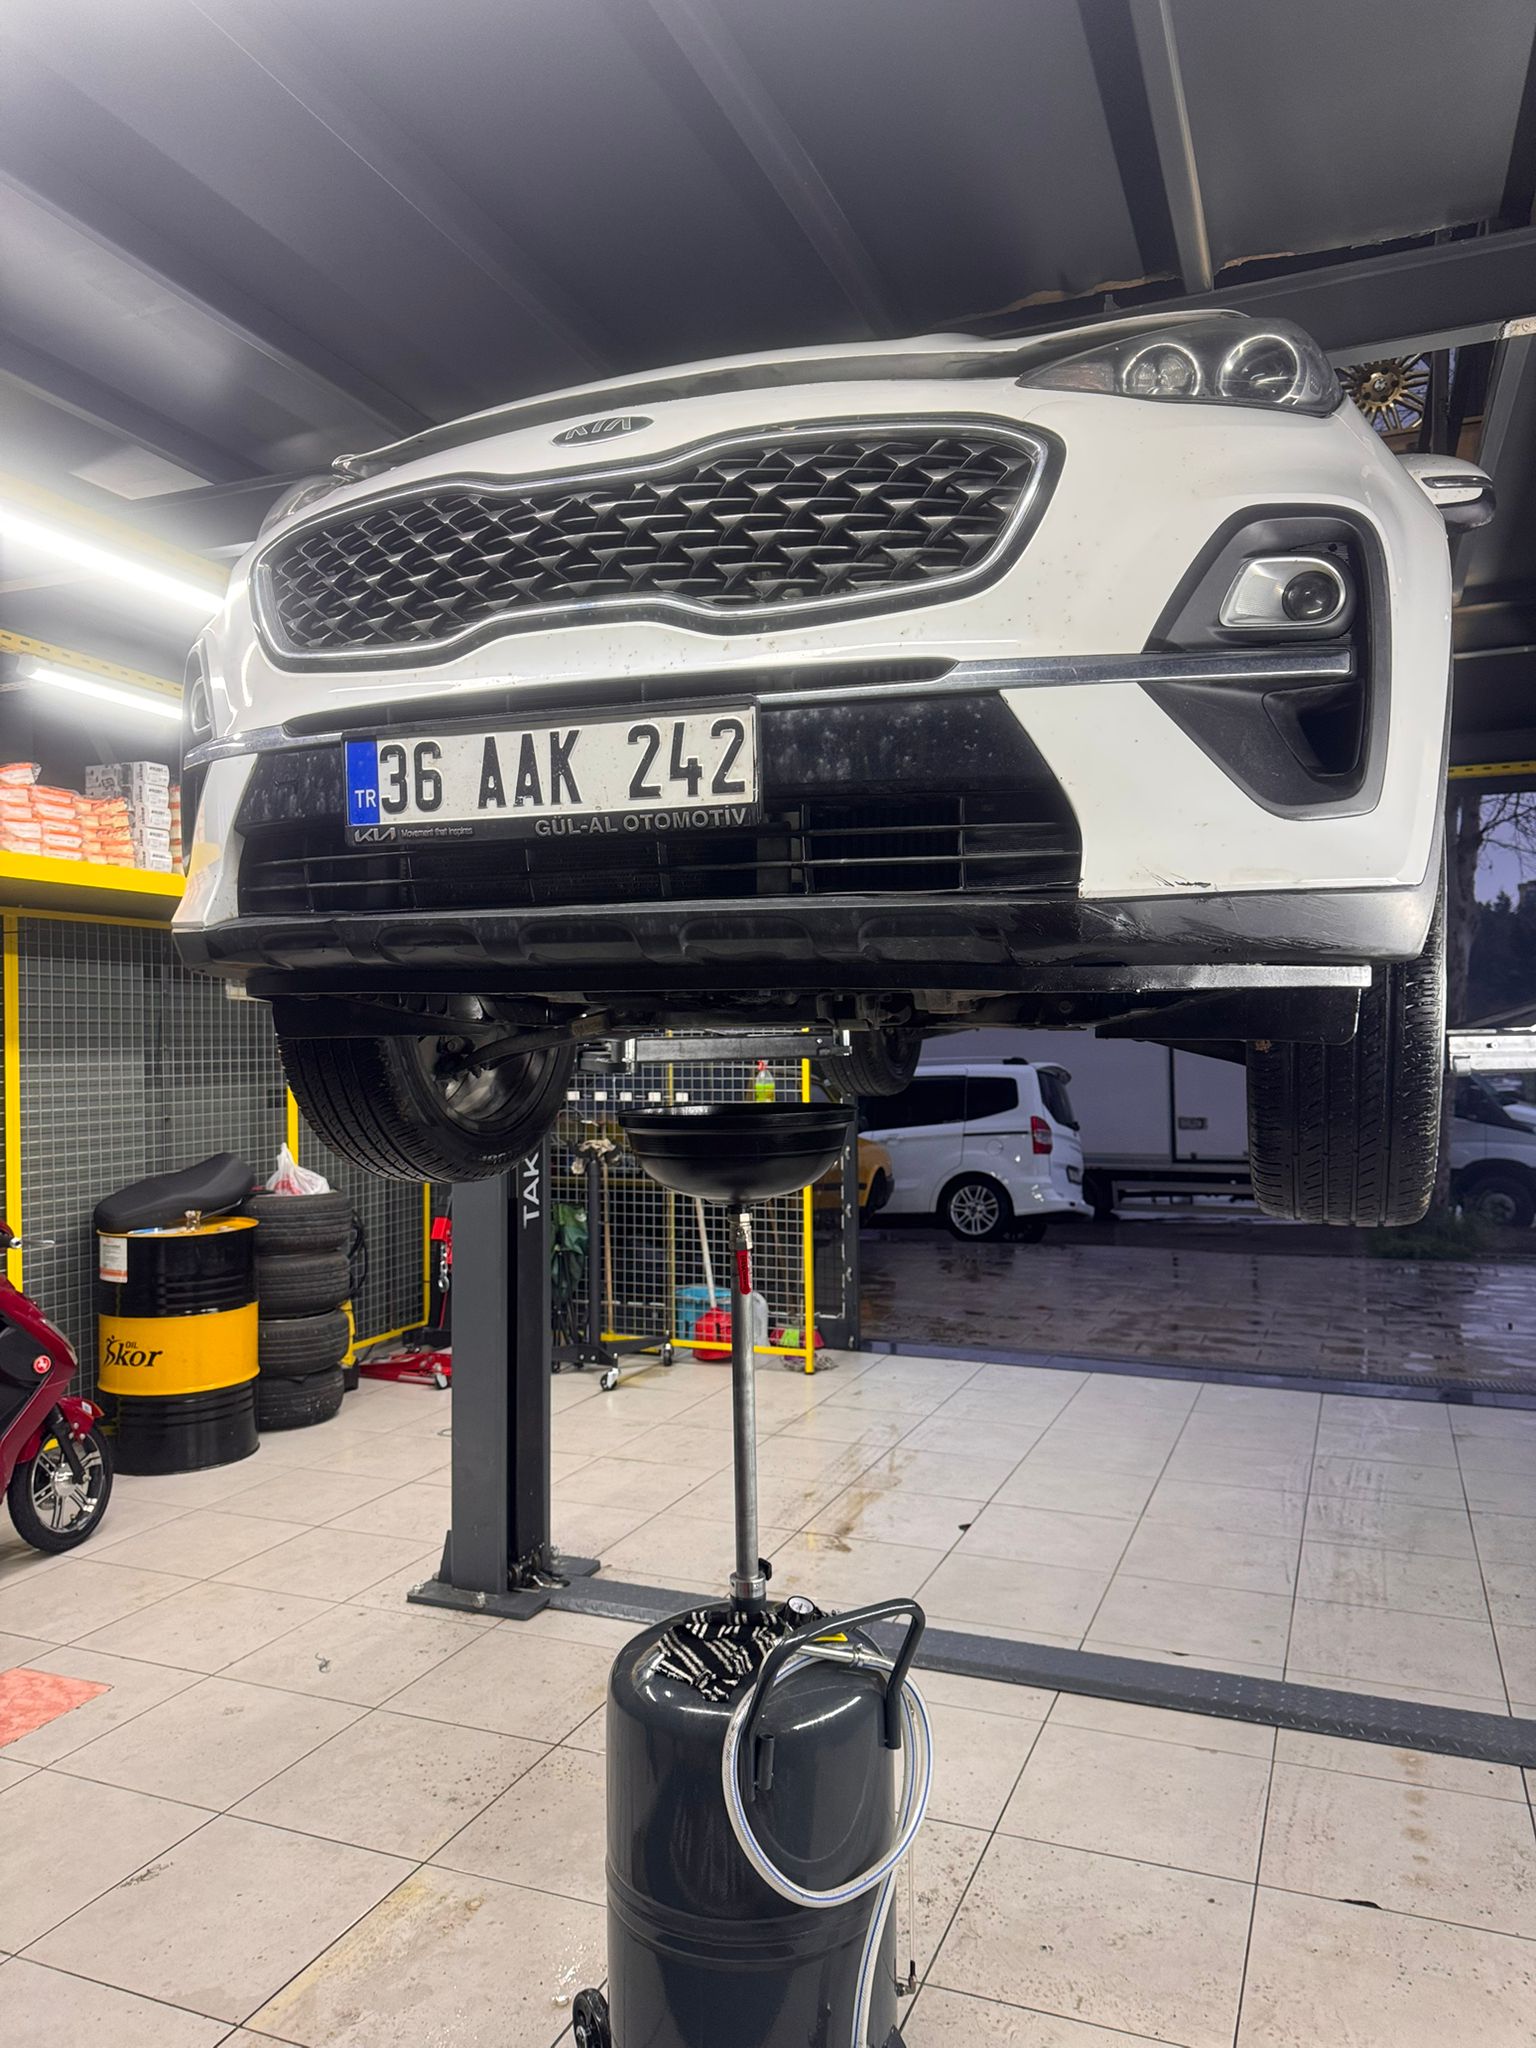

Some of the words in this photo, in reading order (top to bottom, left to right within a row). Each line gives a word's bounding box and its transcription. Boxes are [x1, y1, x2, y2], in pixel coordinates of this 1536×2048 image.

[566, 416, 632, 440] KIA
[379, 740, 443, 815] 36
[477, 729, 583, 810] AAK
[627, 717, 746, 801] 242
[354, 788, 377, 808] TR
[535, 816, 618, 836] GÜL-AL
[623, 805, 747, 832] OTOMOTİV
[354, 827, 396, 842] KIA
[125, 1341, 139, 1349] OIL
